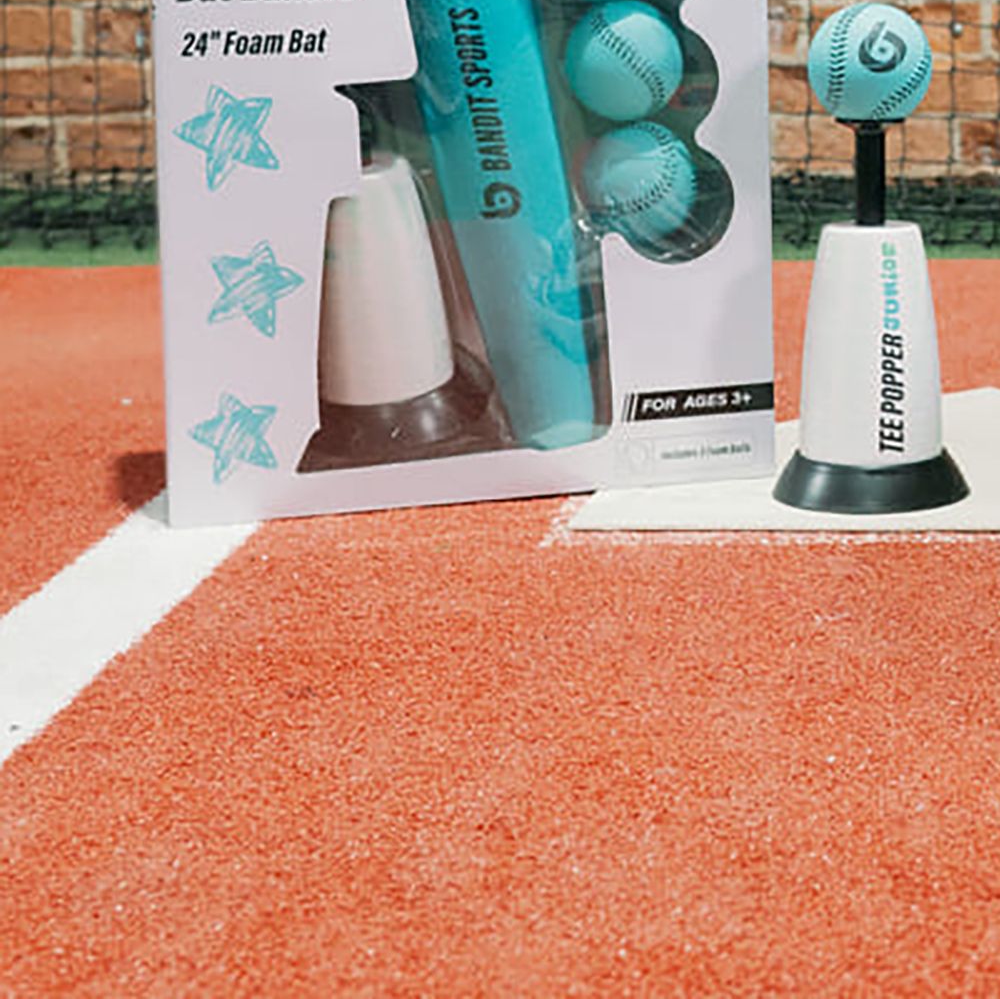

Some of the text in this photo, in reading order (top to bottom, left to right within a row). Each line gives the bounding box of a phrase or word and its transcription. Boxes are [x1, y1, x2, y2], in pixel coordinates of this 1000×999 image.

[223, 30, 284, 56] Foam
[288, 28, 328, 54] Bat
[448, 6, 494, 89] SPORTS
[466, 94, 512, 172] BANDIT
[642, 391, 753, 414] FOR AGES 3+
[880, 333, 905, 416] POPPER
[879, 417, 905, 453] TEE
